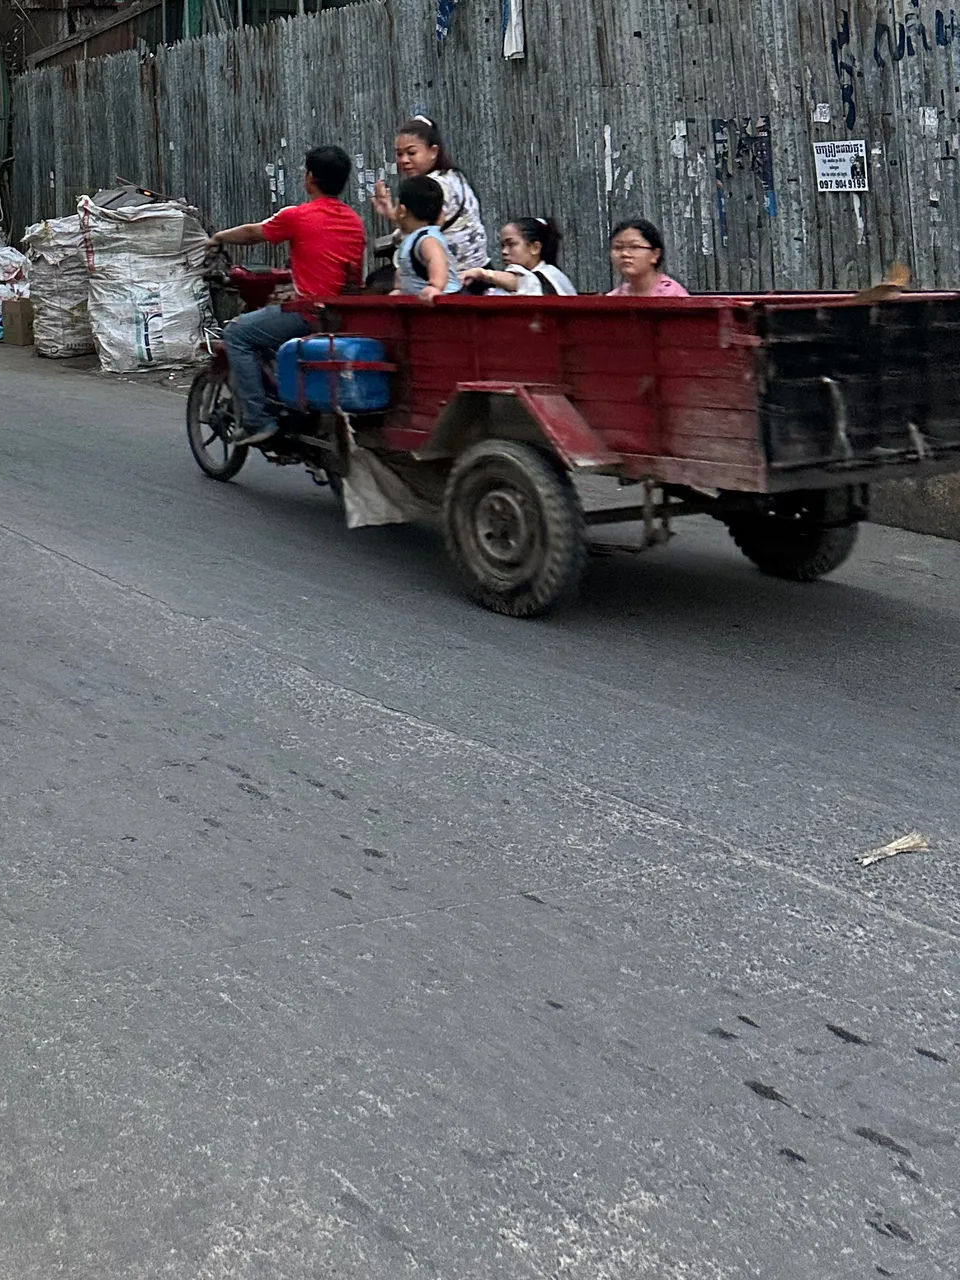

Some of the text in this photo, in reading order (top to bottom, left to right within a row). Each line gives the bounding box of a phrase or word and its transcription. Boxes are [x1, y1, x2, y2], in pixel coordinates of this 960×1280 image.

[819, 179, 866, 189] 097 904 9199
